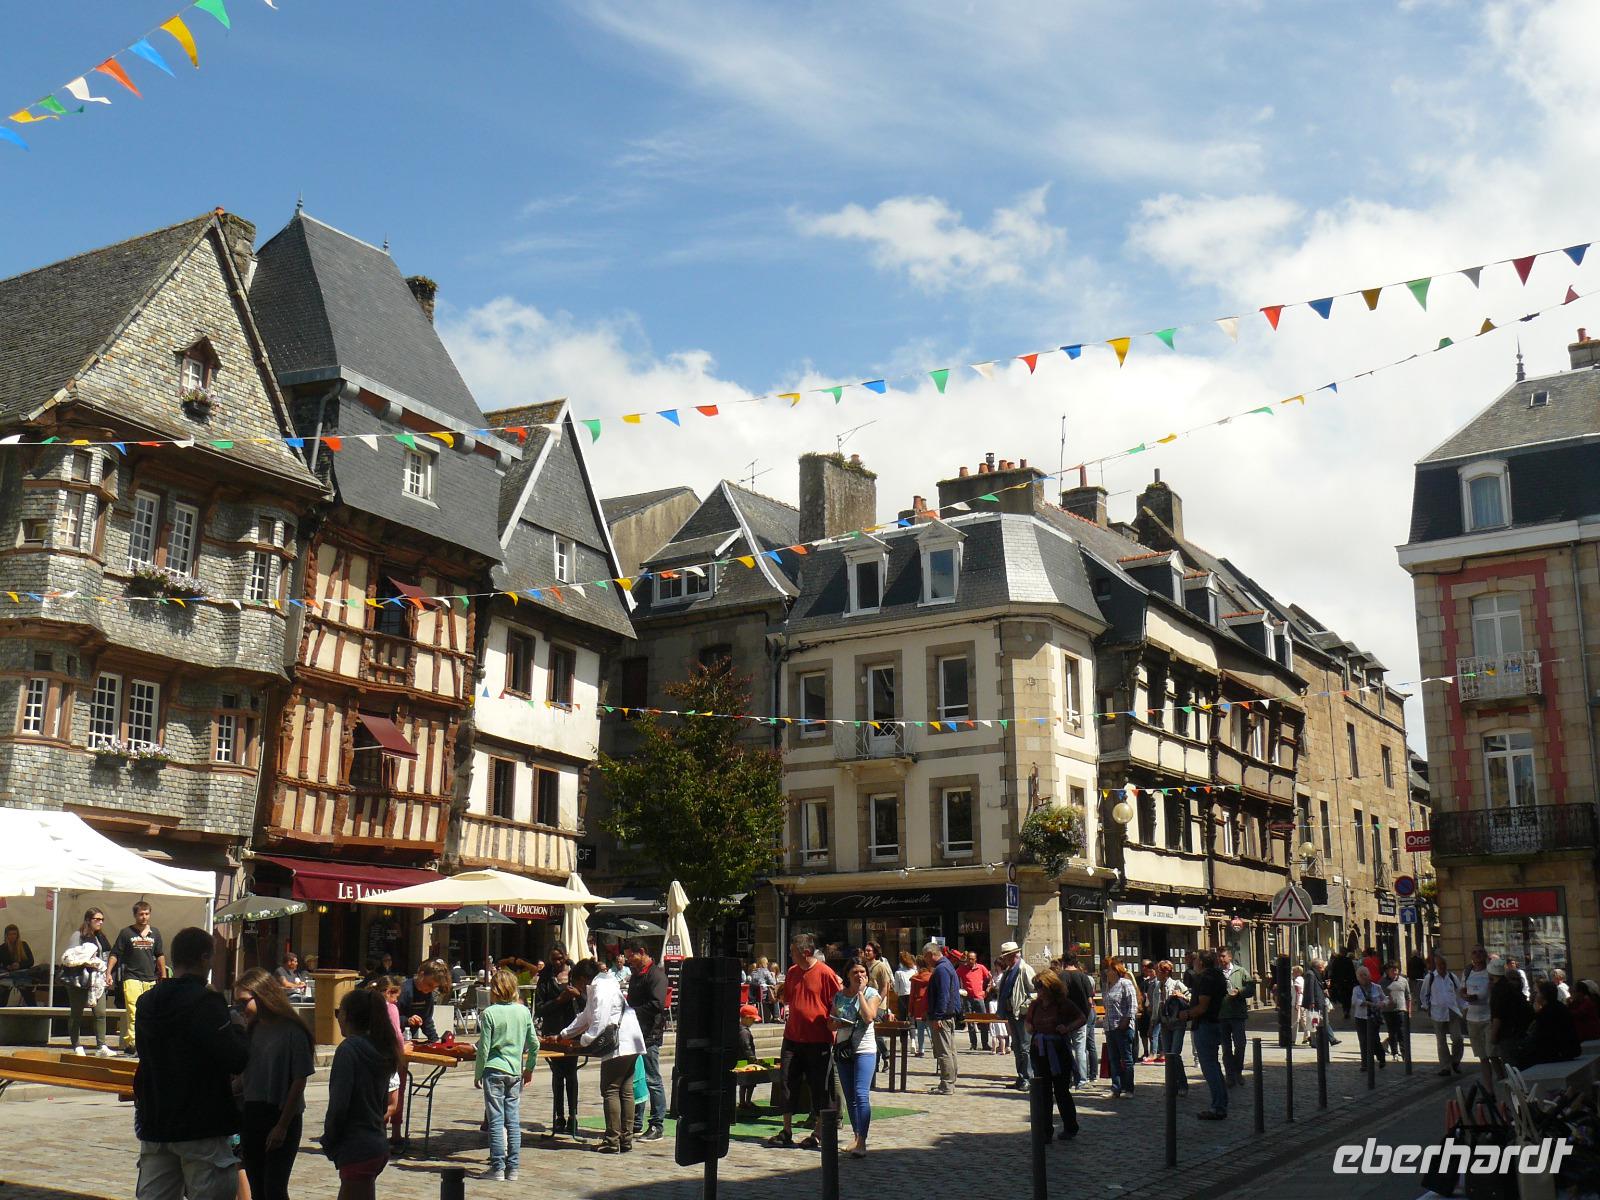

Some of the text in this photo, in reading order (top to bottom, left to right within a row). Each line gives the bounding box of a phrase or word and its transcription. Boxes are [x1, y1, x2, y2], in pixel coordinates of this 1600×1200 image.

[1407, 835, 1431, 846] ORP
[337, 882, 354, 900] LE
[516, 903, 548, 916] BOUCHON
[1482, 896, 1519, 910] ORPI
